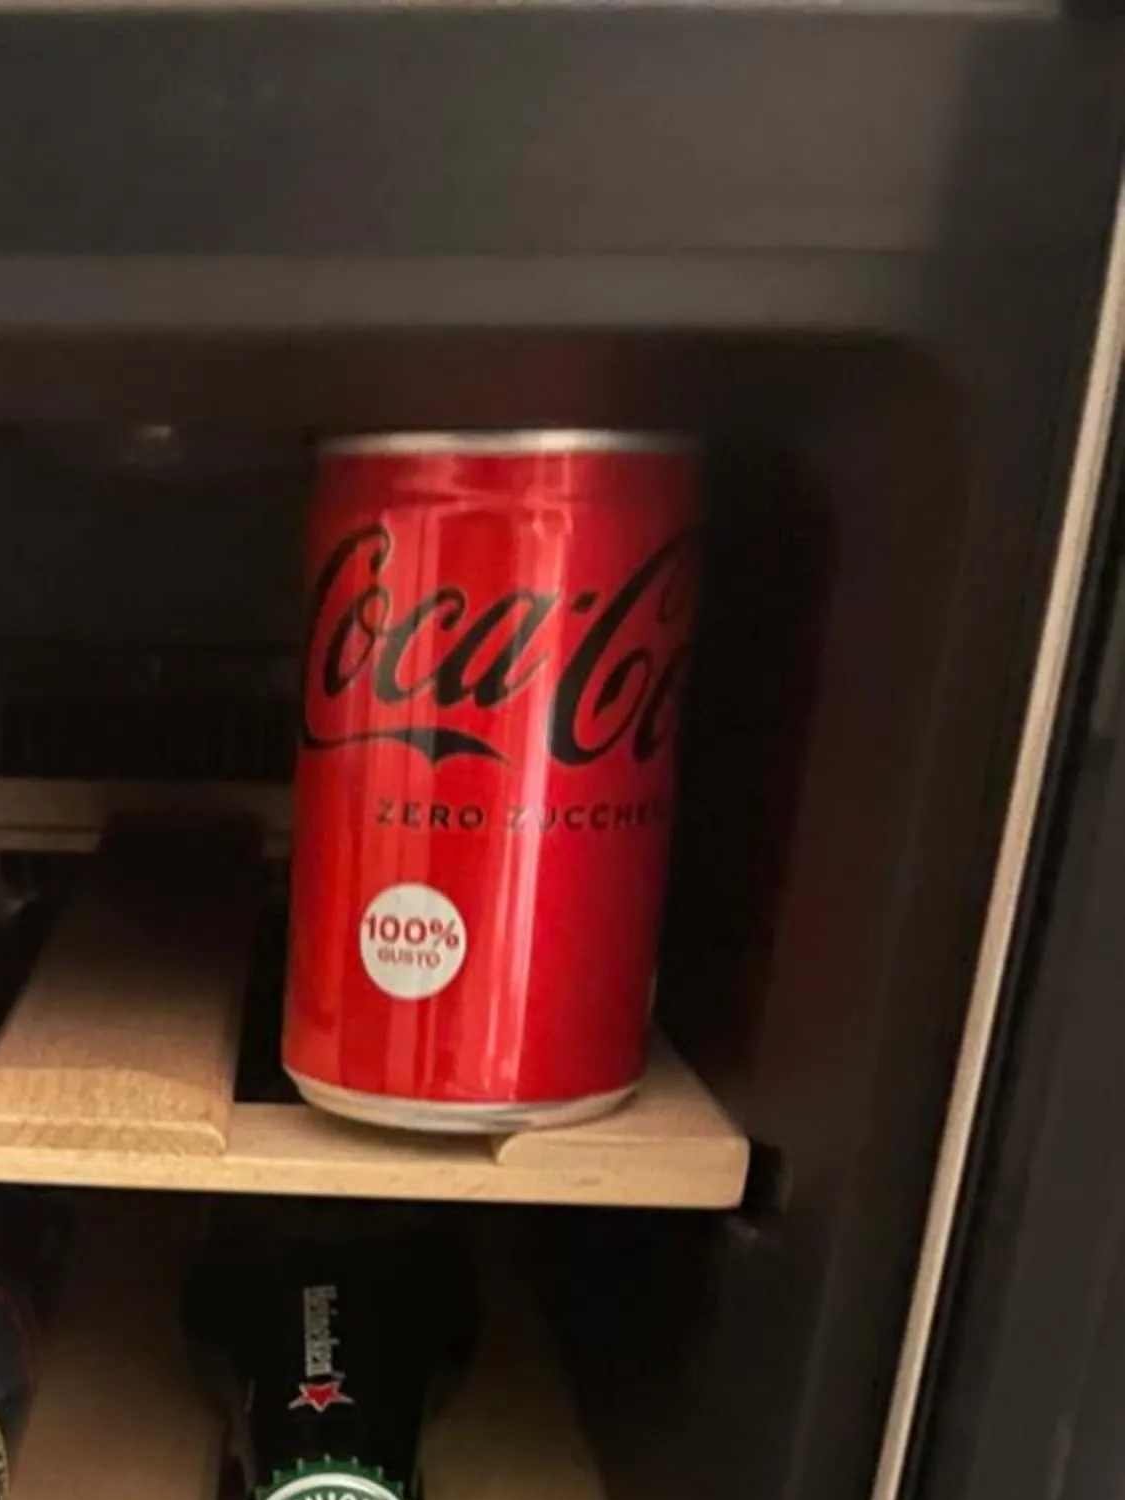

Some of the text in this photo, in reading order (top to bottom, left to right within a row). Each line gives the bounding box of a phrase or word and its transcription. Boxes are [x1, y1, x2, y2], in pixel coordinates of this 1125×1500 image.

[376, 799, 661, 833] ZERO ZUCCHE
[364, 913, 461, 951] 100%
[377, 947, 442, 970] GUSTO
